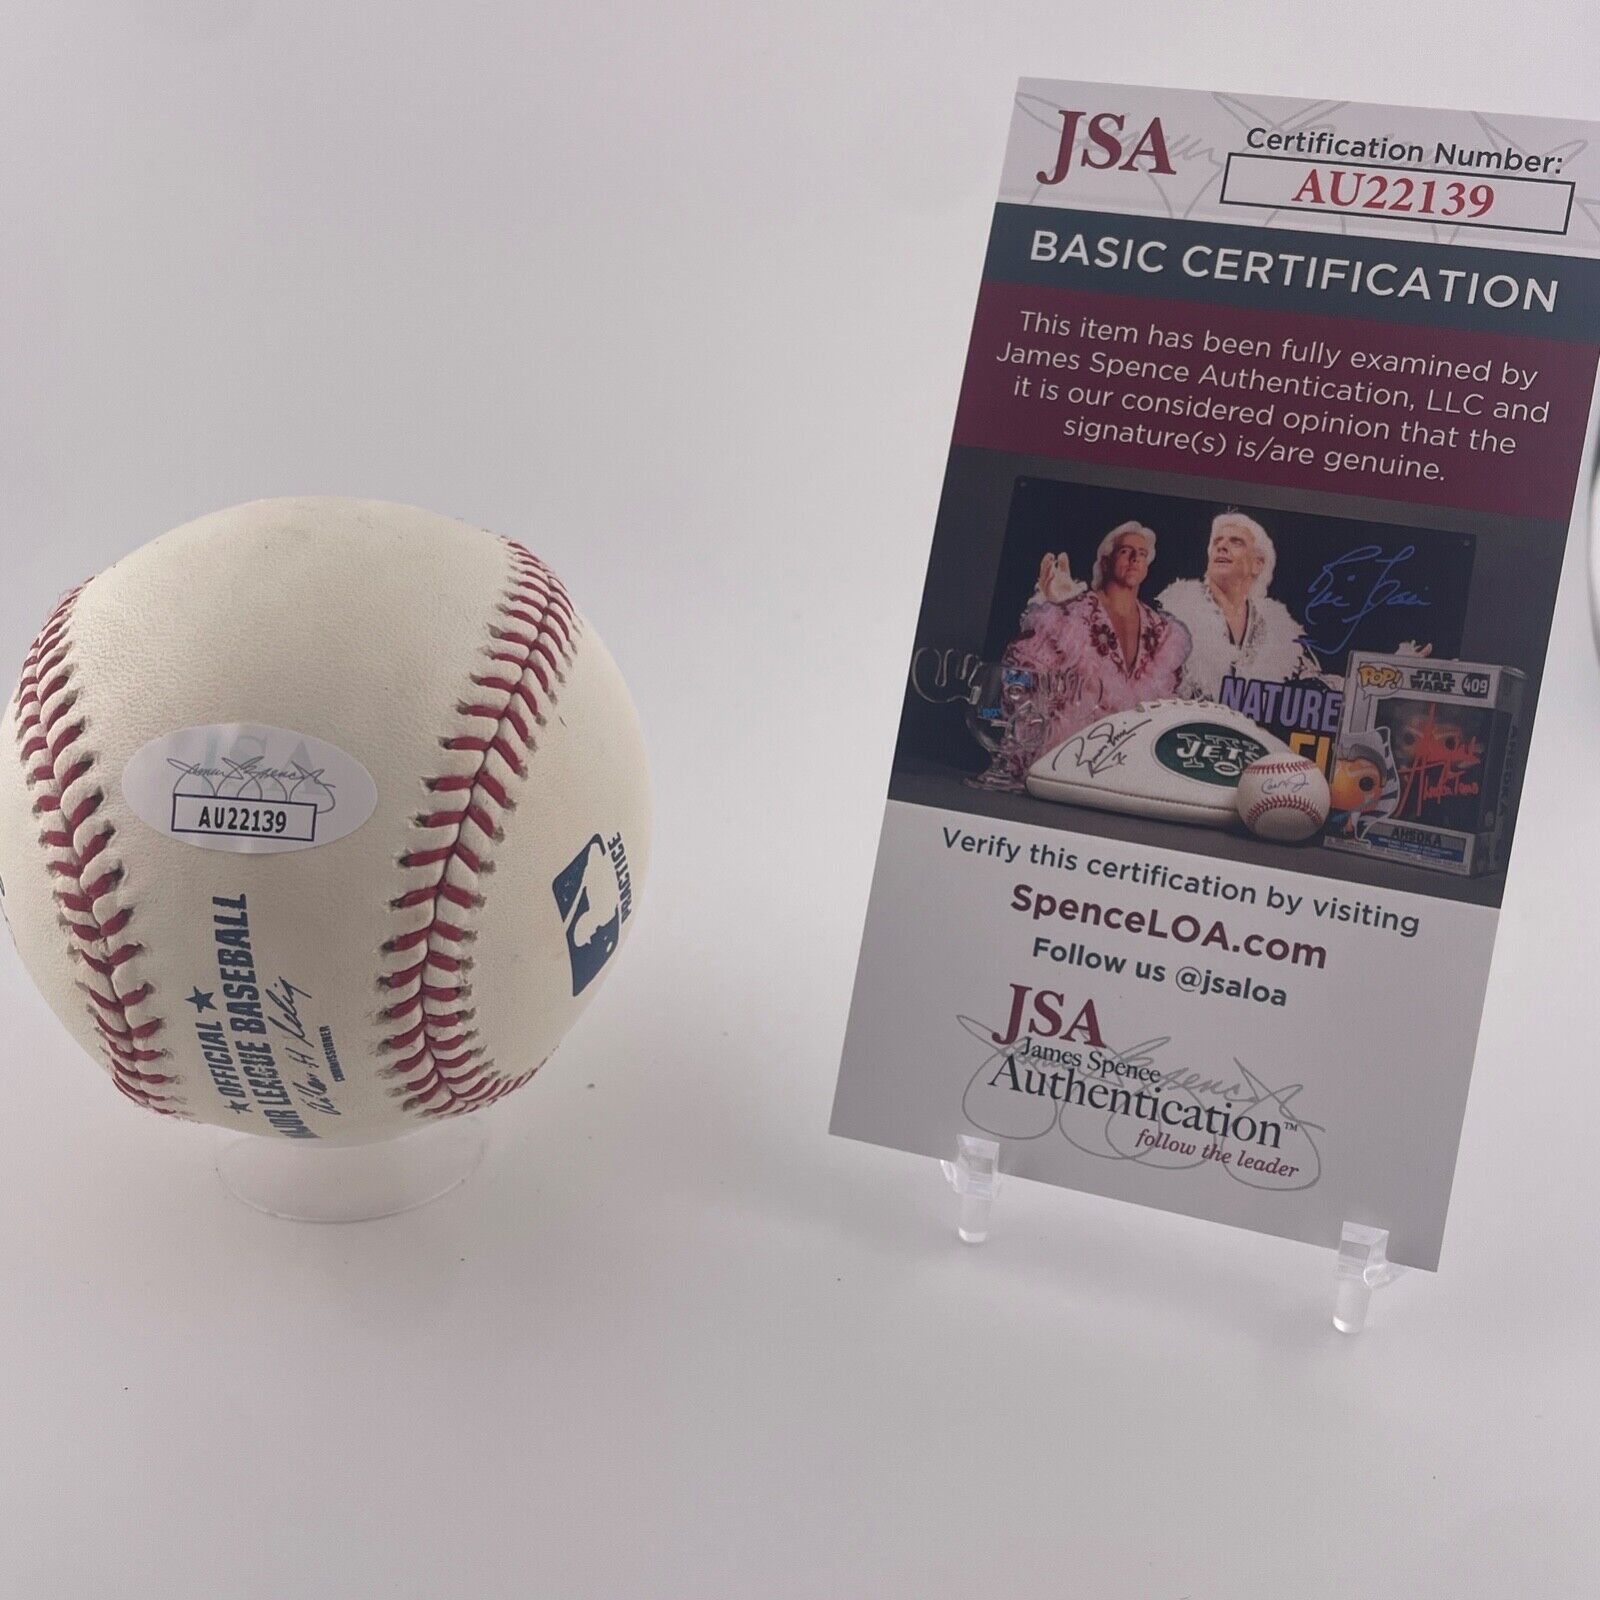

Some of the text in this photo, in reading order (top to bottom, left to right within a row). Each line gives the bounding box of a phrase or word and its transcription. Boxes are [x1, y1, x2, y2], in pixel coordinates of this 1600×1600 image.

[1035, 109, 1177, 186] JSA
[1247, 128, 1562, 174] Certification Number:
[1291, 167, 1495, 219] AU22139
[1031, 230, 1558, 312] BASIC CERTIFICATION
[996, 342, 1549, 423] James Spence Authentication, LLC and
[1021, 311, 1538, 390] This item has been fully examined by
[1014, 378, 1515, 454] it is our considered opinion that the
[1064, 420, 1444, 480] signature(s) is/are genuine.
[1220, 677, 1345, 732] NATURE
[1463, 678, 1489, 694] 409
[198, 806, 287, 834] AU22139
[607, 831, 632, 924] PRACTICE
[943, 827, 1419, 937] Verify this certification by visiting
[1011, 884, 1326, 969] SpenceLOA.com
[212, 893, 267, 1035] BASEBALL
[1033, 937, 1286, 1006] Follow us @jsaloa
[992, 983, 1107, 1048] JSA
[195, 1020, 246, 1098] OFFICIAL
[235, 1039, 293, 1106] LEAGUE
[1020, 1036, 1162, 1083] James Spence
[1135, 1128, 1300, 1178] follow the leader
